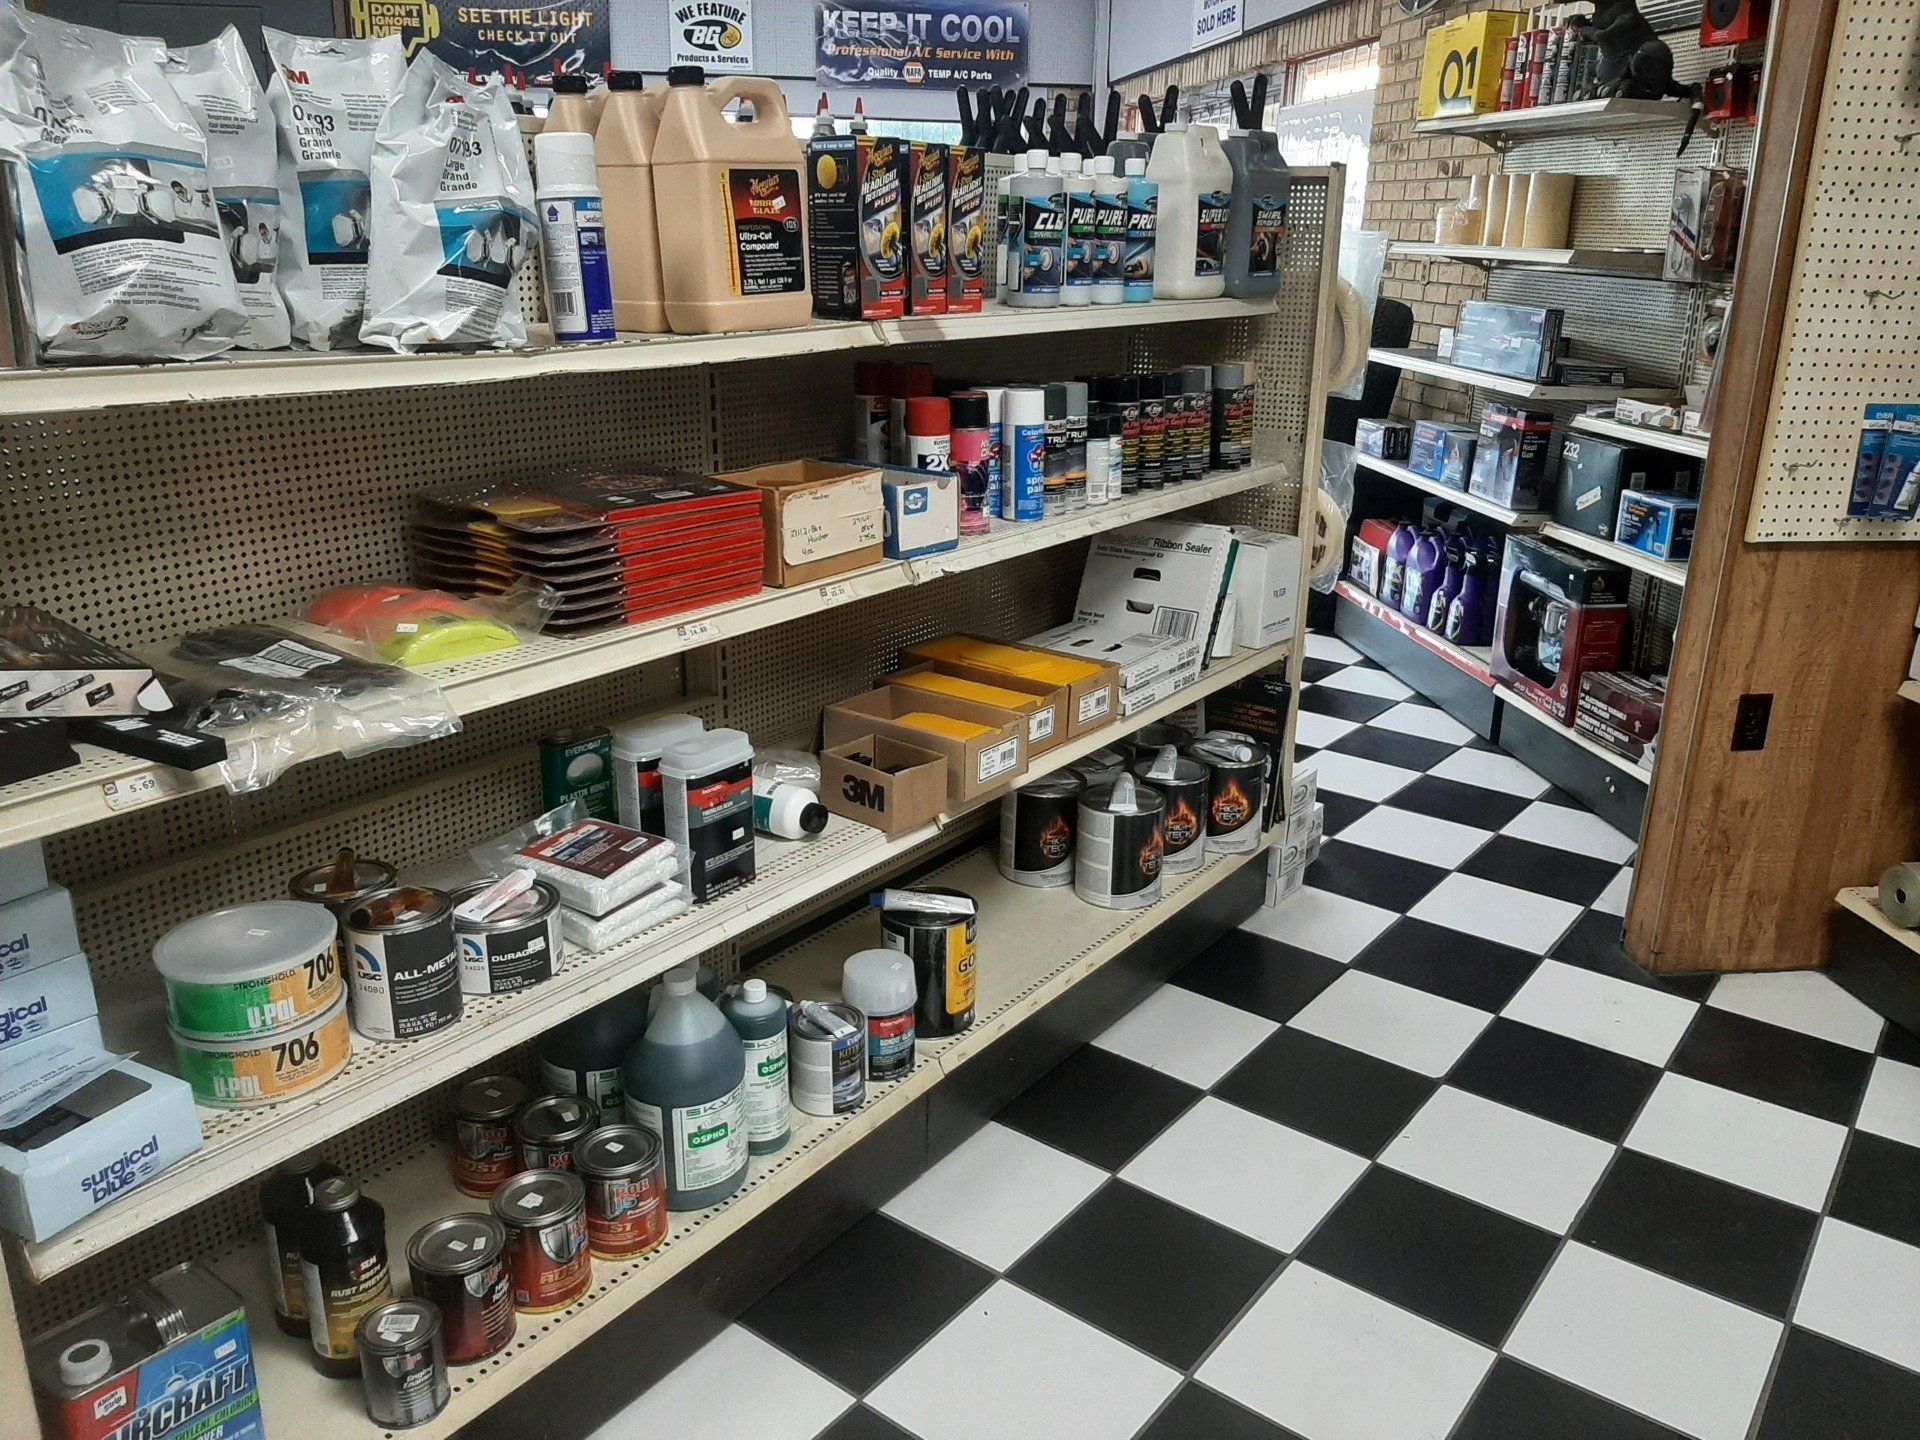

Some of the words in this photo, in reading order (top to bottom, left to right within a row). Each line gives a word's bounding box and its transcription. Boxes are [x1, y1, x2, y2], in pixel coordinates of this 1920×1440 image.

[371, 5, 420, 18] DON'T
[458, 7, 493, 24] SEE
[499, 9, 535, 25] THE
[538, 11, 594, 27] LIGHT
[674, 6, 697, 23] WE
[697, 2, 748, 25] FEATURE
[372, 16, 420, 27] IGNORE
[822, 9, 898, 39] KEEP
[906, 13, 932, 41] IT
[940, 14, 1020, 44] COOL
[1197, 14, 1216, 36] SOLD
[1216, 5, 1237, 28] HERE
[478, 29, 525, 43] CHECK
[529, 30, 547, 43] IT
[551, 30, 578, 44] OUT
[691, 22, 721, 47] BG
[677, 53, 709, 64] Products
[710, 56, 716, 64] &
[717, 54, 749, 65] Services
[828, 43, 910, 59] Professional
[912, 45, 931, 60] A/C
[936, 47, 982, 61] Service
[986, 47, 1015, 61] With
[867, 66, 898, 79] Quality
[905, 66, 923, 78] NAPA
[928, 70, 951, 80] TEMP
[953, 70, 969, 81] A/C
[971, 71, 992, 81] Parts
[293, 105, 335, 132] 093
[300, 137, 333, 148] Grand
[442, 171, 470, 182] Grand
[862, 168, 898, 196] HEADLIGHT
[439, 182, 478, 192] Grande
[874, 192, 897, 210] PLUS
[1096, 209, 1123, 226] PURE
[1257, 210, 1282, 219] SWIRL
[740, 231, 772, 241] Ultra-Cut
[741, 241, 779, 251] Compound
[1563, 440, 1581, 459] 232
[926, 454, 951, 471] 2X
[1154, 537, 1183, 551] Ribbon
[1185, 541, 1213, 554] Sealer
[129, 779, 155, 793] 5.69
[842, 773, 886, 813] 3M
[1218, 804, 1244, 813] HIGH
[1218, 811, 1245, 821] TECK
[1167, 830, 1193, 840] TECK
[491, 946, 546, 962] DURAG
[303, 945, 335, 990] 706
[957, 953, 975, 973] GO
[232, 969, 297, 991] STRONGHOLD
[357, 970, 383, 980] USC
[271, 1030, 320, 1073] 706
[692, 1127, 727, 1145] OSPHO
[80, 1134, 160, 1192] surgical
[92, 1169, 137, 1204] blue
[331, 1286, 359, 1298] RUST
